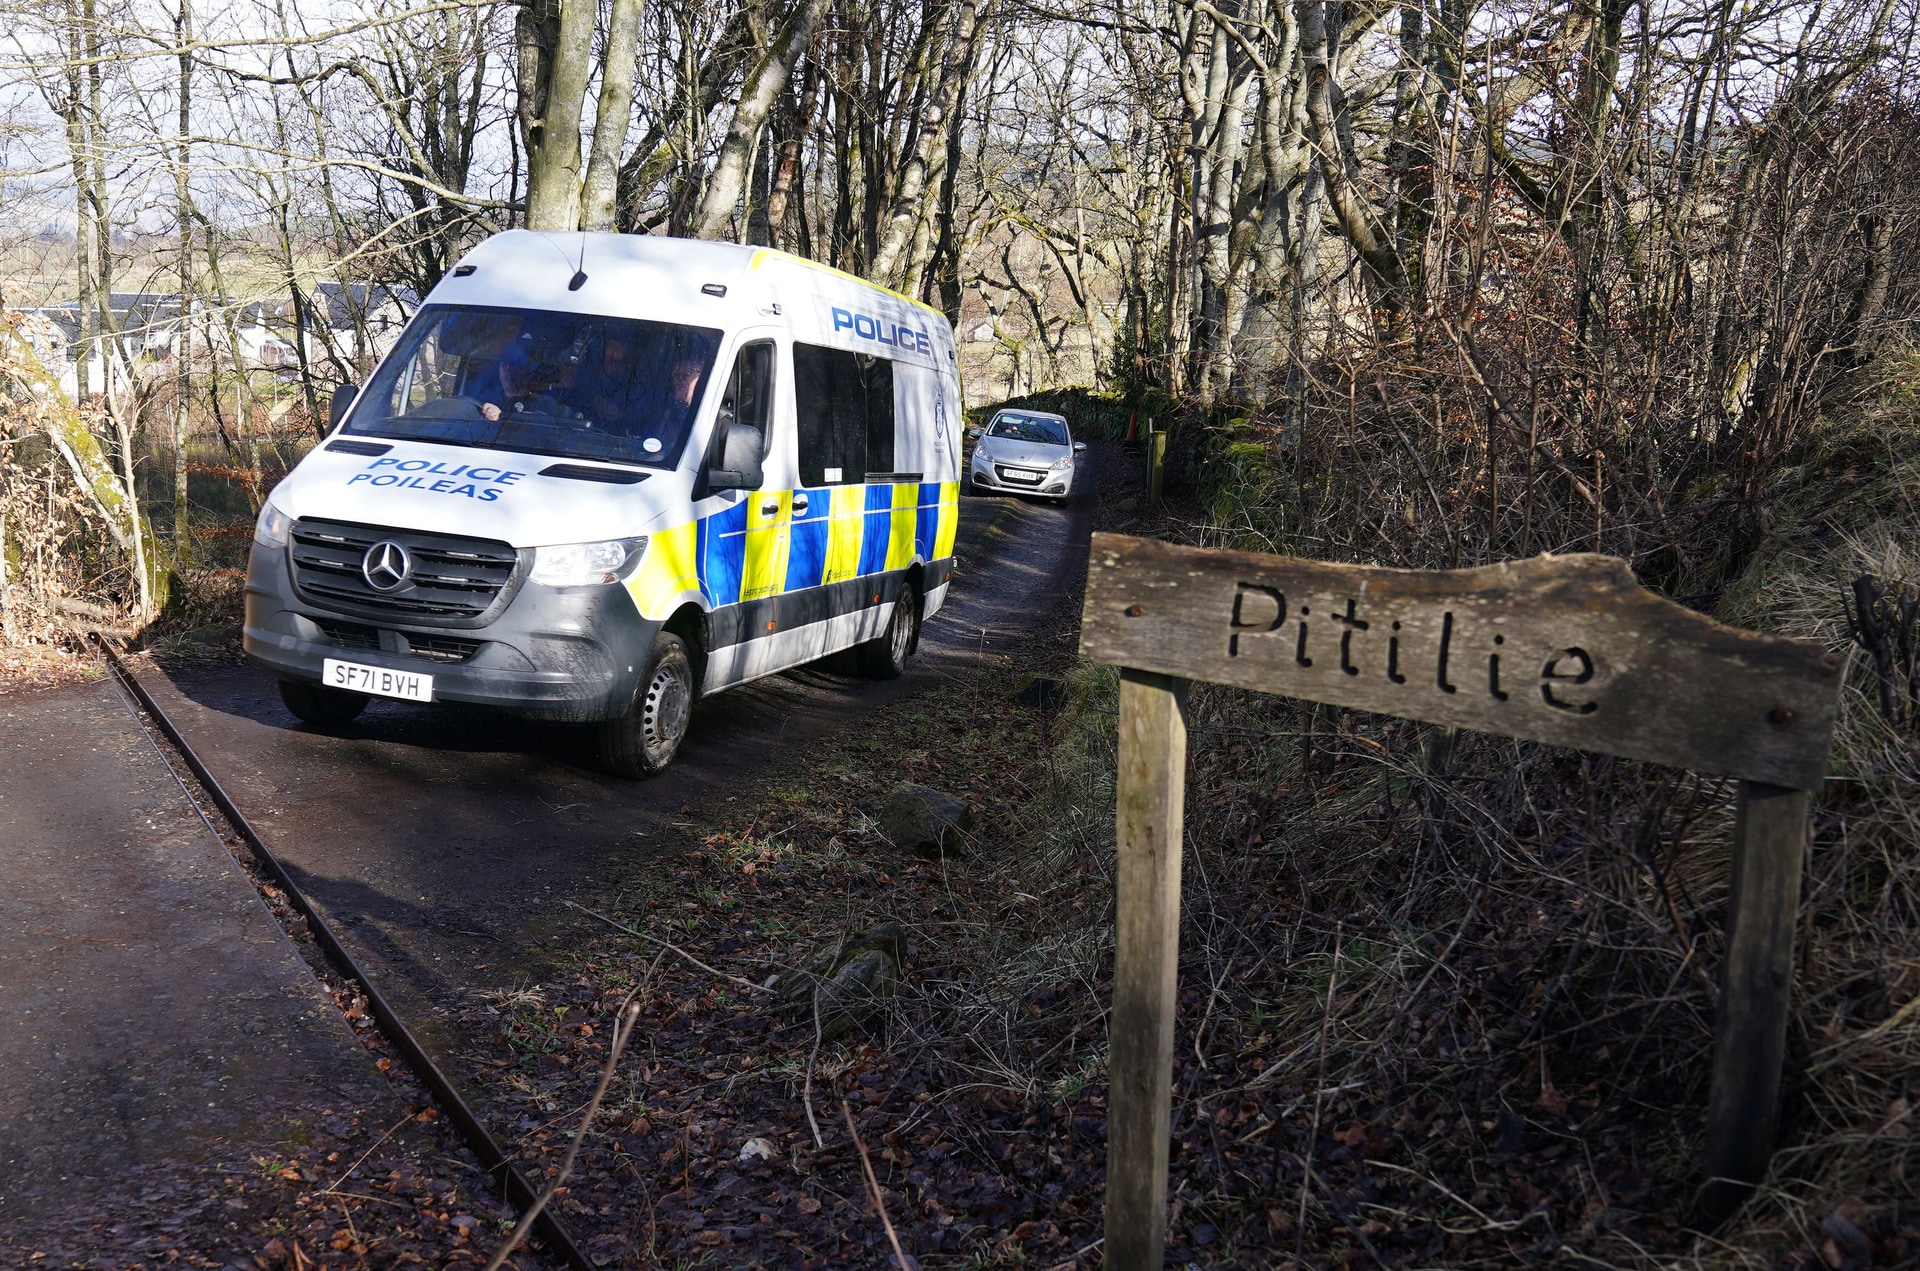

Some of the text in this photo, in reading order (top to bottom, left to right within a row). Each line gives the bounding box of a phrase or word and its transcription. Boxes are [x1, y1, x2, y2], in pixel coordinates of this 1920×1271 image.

[831, 306, 931, 356] POLICE
[346, 473, 504, 502] POILEAS
[367, 458, 527, 486] POLICE
[1227, 581, 1599, 716] Pitilie
[335, 665, 419, 697] SF71 BVH
